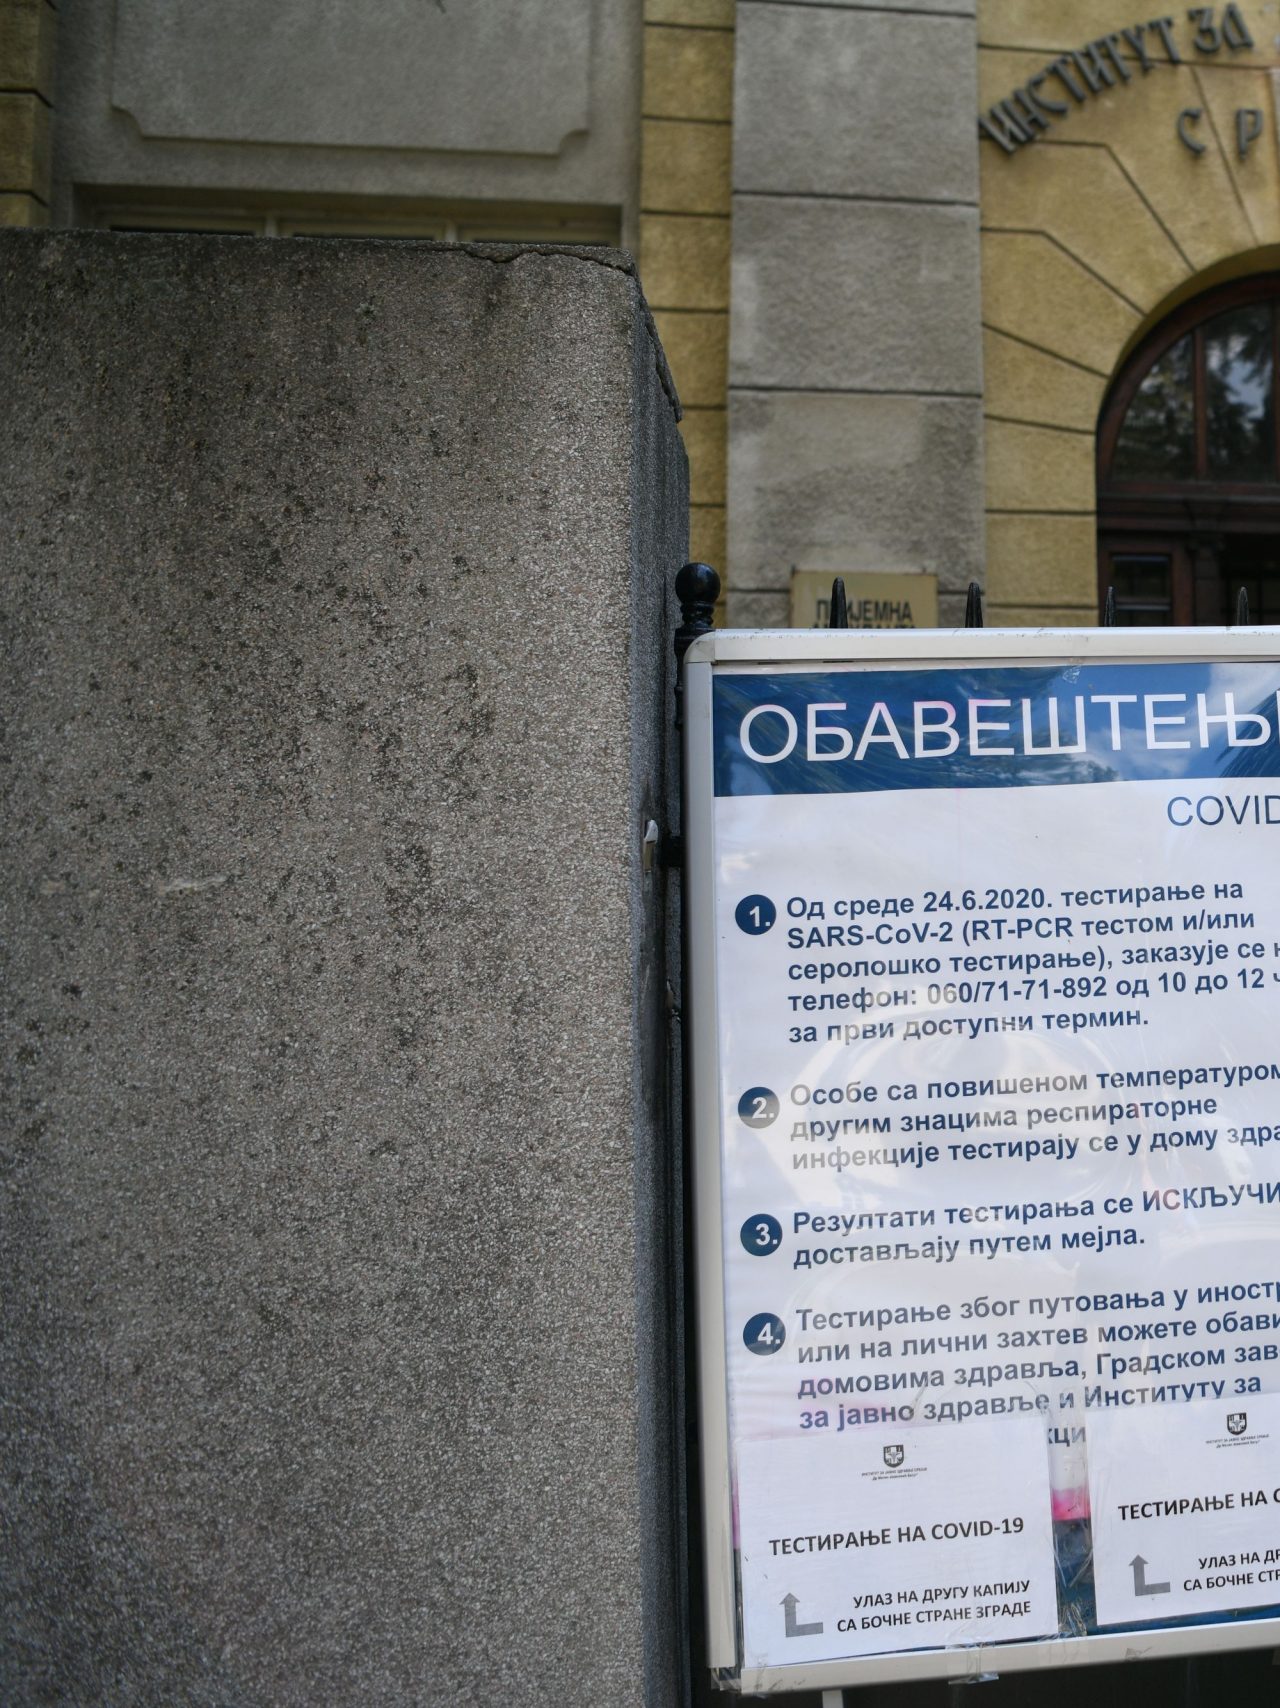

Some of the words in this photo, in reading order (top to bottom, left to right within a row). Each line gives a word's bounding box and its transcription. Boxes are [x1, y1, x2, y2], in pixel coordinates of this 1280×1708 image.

[786, 896, 826, 921] Од
[833, 897, 915, 921] среде
[922, 887, 1053, 913] 24.6.2020.
[1060, 883, 1206, 909] тестирање
[1213, 882, 1244, 900] на
[787, 920, 954, 950] SARS-CoV-2
[962, 916, 1075, 948] (RT-PCR
[1080, 915, 1174, 937] тестом
[1182, 908, 1255, 931] и/или
[787, 957, 942, 985] серолошко
[948, 944, 1113, 976] тестирање),
[1121, 938, 1230, 967] заказује
[1237, 942, 1266, 959] се
[786, 986, 917, 1014] телефон:
[927, 975, 1108, 1005] 060/71-71-892
[1115, 978, 1150, 999] од
[1157, 971, 1187, 994] 10
[1194, 974, 1229, 996] до
[1236, 967, 1265, 990] 12
[788, 1025, 819, 1044] за
[827, 1021, 895, 1046] први
[902, 1015, 1034, 1042] доступни
[1041, 1009, 1149, 1034] термин.
[790, 1080, 879, 1106] Особе
[886, 1083, 918, 1102] са
[927, 1074, 1088, 1100] повишеном
[789, 1116, 892, 1143] другим
[899, 1109, 1018, 1133] знацима
[1026, 1097, 1218, 1131] респираторне
[792, 1140, 940, 1174] инфекције
[947, 1133, 1080, 1163] тестирају
[1088, 1134, 1119, 1153] се
[1125, 1133, 1142, 1157] у
[1149, 1128, 1219, 1153] дому
[793, 1209, 936, 1238] Резултати
[943, 1199, 1095, 1226] тестирања
[1103, 1196, 1134, 1215] се
[792, 1234, 961, 1271] достављају
[969, 1233, 1052, 1261] путем
[1061, 1224, 1145, 1254] мејла.
[795, 1303, 952, 1332] Тестирање
[959, 1295, 1021, 1320] због
[1028, 1290, 1166, 1320] путовања
[1172, 1288, 1189, 1312] у
[798, 1343, 851, 1364] или
[860, 1340, 893, 1360] на
[900, 1333, 988, 1357] лични
[996, 1327, 1089, 1349] захтев
[1097, 1319, 1198, 1343] можете
[796, 1369, 945, 1401] домовима
[953, 1359, 1087, 1389] здравља,
[1096, 1348, 1226, 1381] Градском
[799, 1410, 830, 1430] за
[836, 1403, 915, 1433] јавно
[923, 1393, 1052, 1424] здравље
[1059, 1392, 1075, 1410] и
[1084, 1379, 1226, 1409] Институту
[1233, 1376, 1262, 1396] за
[1117, 1492, 1236, 1522] ТЕСТИРАЊЕ
[1240, 1489, 1269, 1508] НА
[767, 1527, 892, 1557] ТЕСТИРАЊЕ
[897, 1525, 927, 1544] НА
[930, 1516, 1025, 1541] COVID-19
[1183, 1578, 1203, 1592] СА
[1205, 1572, 1255, 1590] БОЧНЕ
[1197, 1554, 1237, 1571] УЛАЗ
[1240, 1551, 1261, 1566] НА
[852, 1592, 894, 1609] УЛАЗ
[896, 1589, 919, 1605] НА
[921, 1585, 970, 1605] ДРУГУ
[972, 1579, 1031, 1598] КАПИЈУ
[836, 1618, 858, 1633] СА
[860, 1611, 913, 1631] БОЧНЕ
[915, 1606, 973, 1624] СТРАНЕ
[975, 1600, 1032, 1619] ЗГРАДЕ
